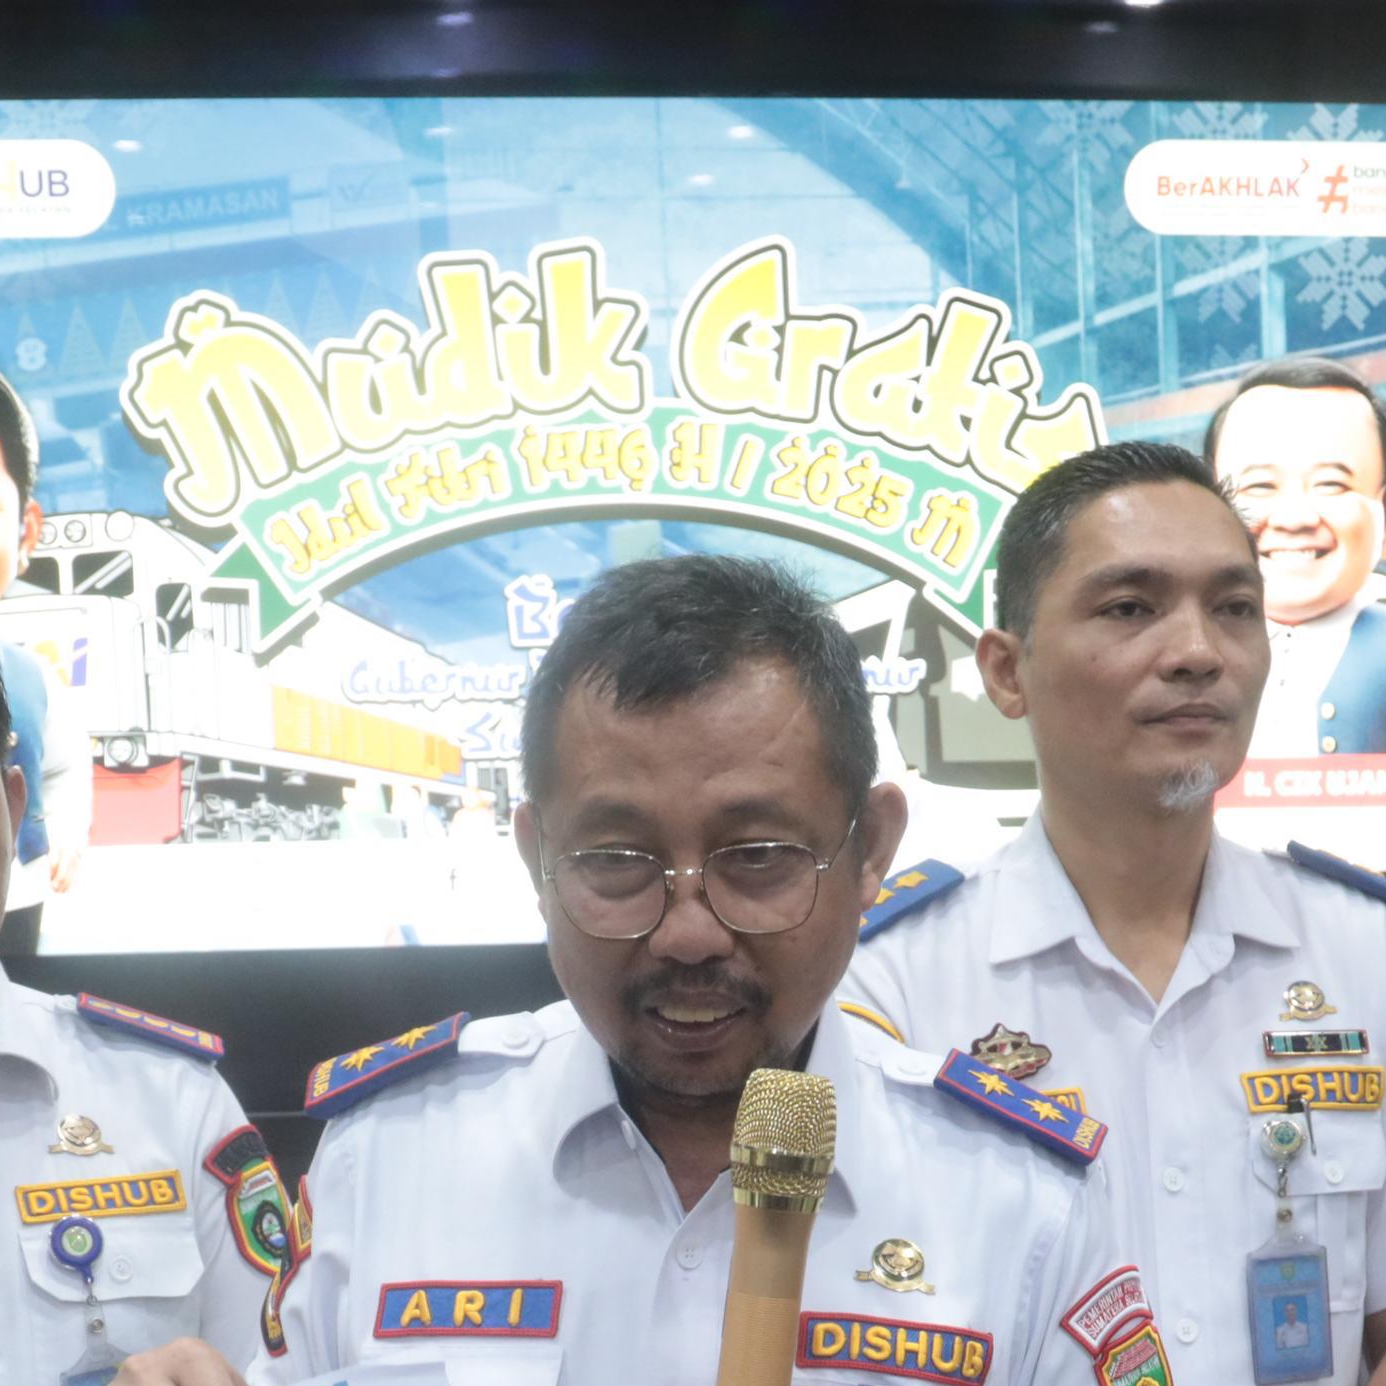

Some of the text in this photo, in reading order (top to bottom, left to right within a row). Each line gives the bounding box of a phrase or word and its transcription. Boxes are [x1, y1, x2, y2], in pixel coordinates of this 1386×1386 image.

[1156, 175, 1300, 198] BerAKHLAK
[135, 243, 644, 511] Mudik
[518, 424, 649, 493] 1446
[771, 435, 910, 530] 2025
[1254, 1071, 1383, 1105] DISHUB
[28, 1177, 175, 1215] DISHUB
[400, 1288, 525, 1327] ARI
[812, 1321, 987, 1380] DISHUB
